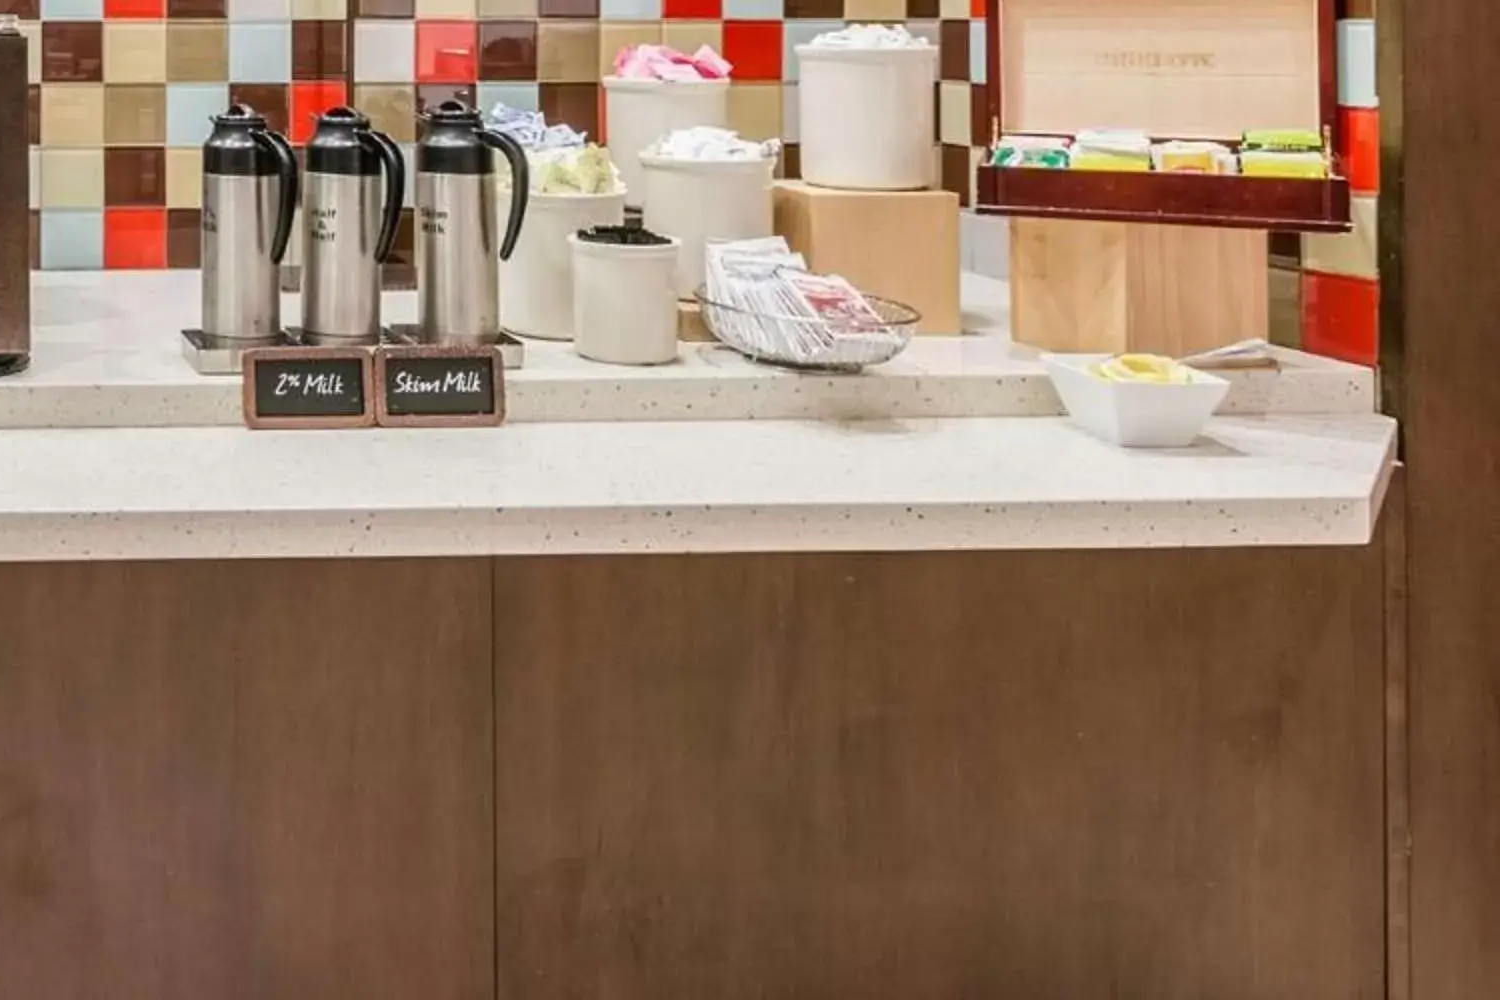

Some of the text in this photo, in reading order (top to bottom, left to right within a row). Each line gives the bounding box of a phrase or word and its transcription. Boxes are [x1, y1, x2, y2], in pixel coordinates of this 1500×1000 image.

[275, 372, 344, 396] 2% Milk
[393, 371, 482, 394] Skim Milk
